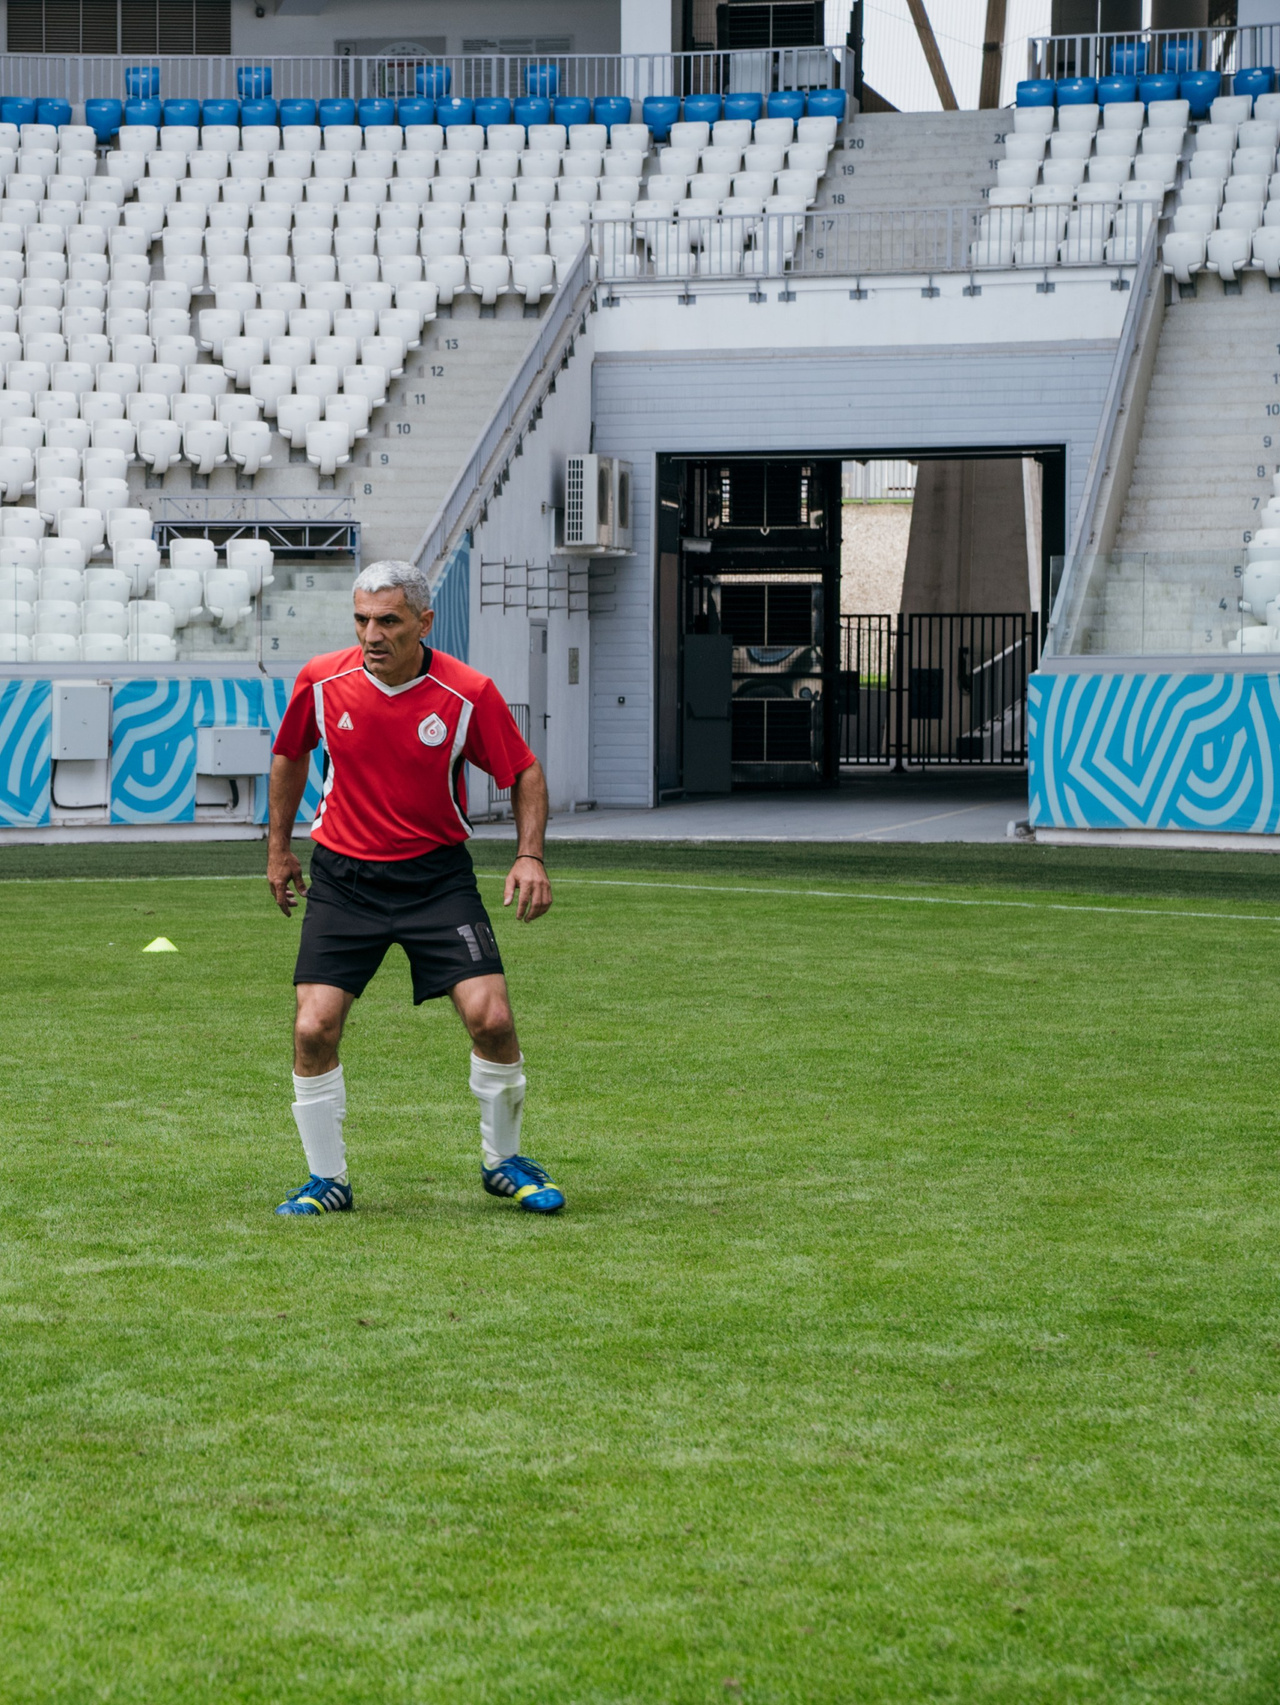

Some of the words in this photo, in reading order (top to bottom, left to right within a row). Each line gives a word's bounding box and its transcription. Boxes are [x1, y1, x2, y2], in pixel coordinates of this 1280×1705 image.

[849, 138, 865, 149] 20
[842, 165, 855, 175] 19
[832, 194, 845, 205] 18
[822, 220, 835, 231] 17
[445, 338, 459, 350] 13
[430, 365, 444, 377] 12
[414, 394, 426, 405] 11
[1265, 403, 1280, 416] 10
[396, 423, 411, 435] 10
[1263, 435, 1272, 448] 9
[380, 453, 389, 465] 9
[1257, 465, 1266, 478] 8
[363, 483, 372, 495] 8
[1251, 497, 1260, 510] 7
[1243, 531, 1252, 543] 6
[1233, 565, 1243, 578] 5
[305, 575, 315, 588] 5
[1219, 597, 1227, 611] 4
[287, 606, 296, 617] 4
[1205, 629, 1213, 643] 3
[271, 637, 280, 650] 3
